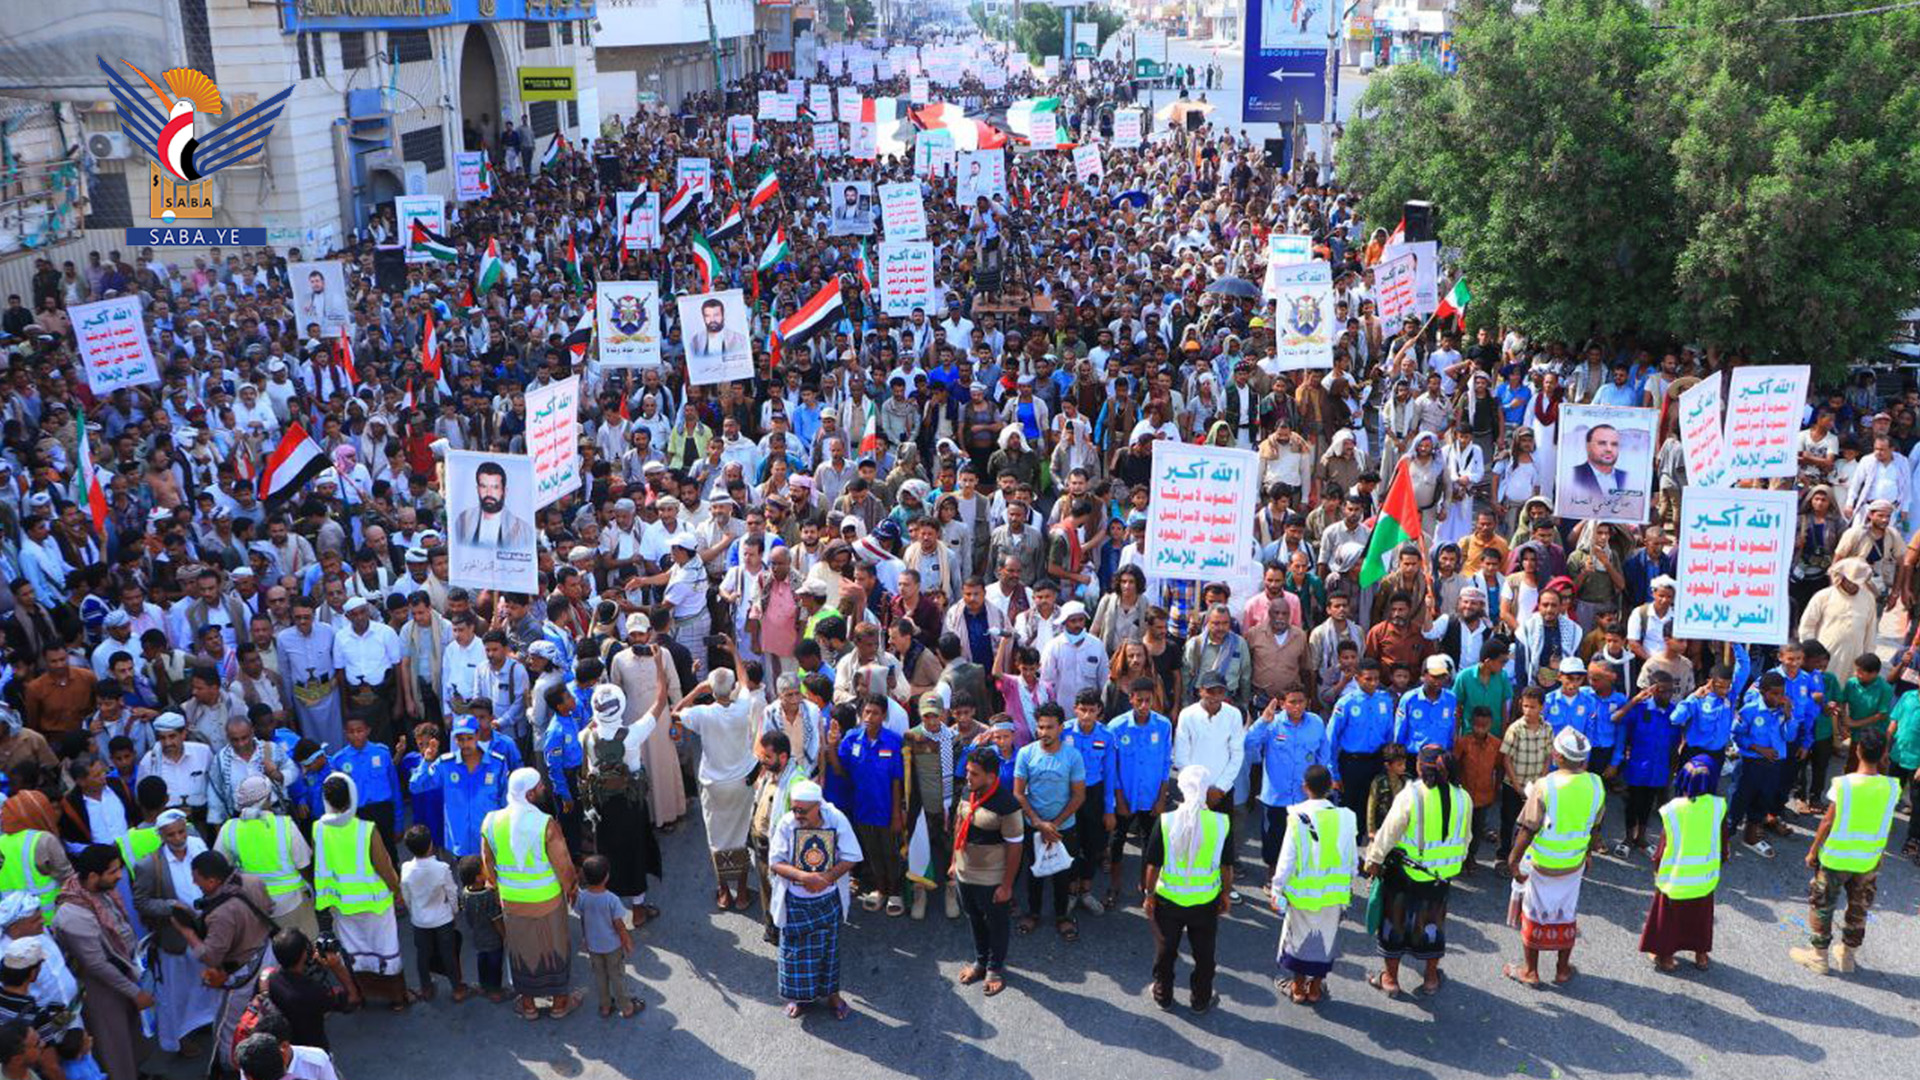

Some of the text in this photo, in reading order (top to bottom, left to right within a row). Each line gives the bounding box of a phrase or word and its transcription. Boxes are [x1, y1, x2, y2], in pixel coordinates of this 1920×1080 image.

[1739, 378, 1795, 401] الله أكبر
[1163, 458, 1240, 484] الله أكبر
[1690, 503, 1781, 532] الله أكبر
[1689, 535, 1778, 556] الموت لأمريكا
[1157, 546, 1196, 569] للإسلام
[1199, 549, 1234, 570] النصر
[1687, 557, 1776, 579] الموت لإسرائيل
[1686, 581, 1775, 598] اللعنة على اليهود
[1684, 602, 1774, 628] النصر للإسلام
